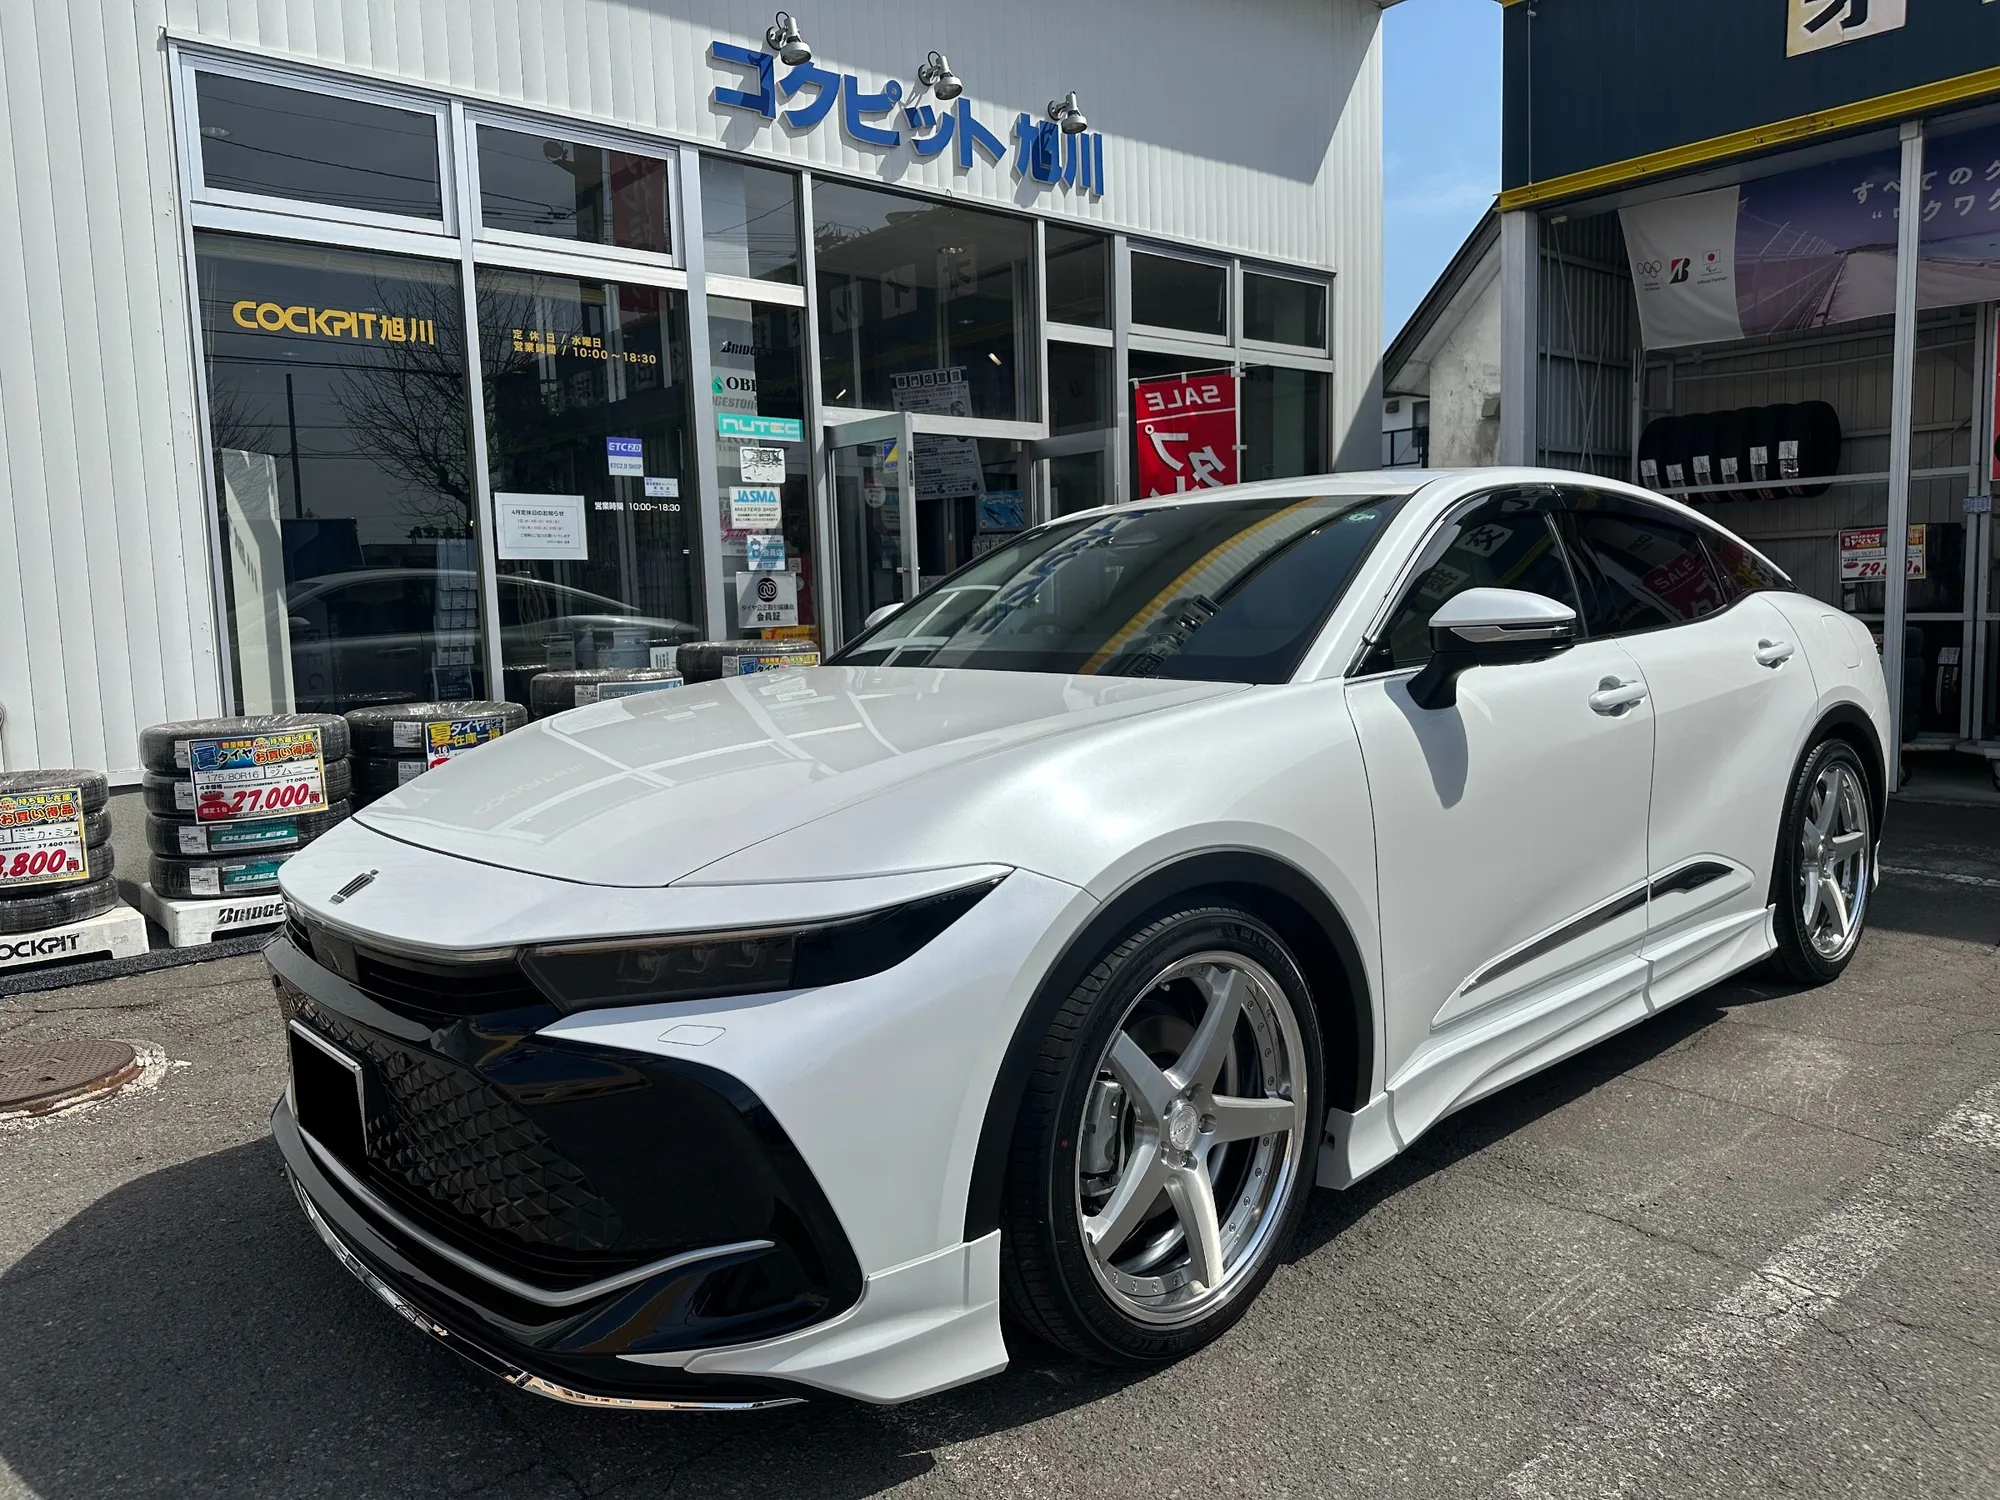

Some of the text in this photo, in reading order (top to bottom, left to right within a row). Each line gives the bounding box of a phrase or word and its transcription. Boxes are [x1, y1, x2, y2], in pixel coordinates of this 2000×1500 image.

[608, 442, 628, 452] ETC
[733, 490, 777, 503] JASMA
[594, 501, 624, 511] 営業時間
[756, 612, 781, 622] 会員証
[254, 741, 316, 764] お買い得品
[437, 745, 448, 754] 16
[207, 770, 260, 782] 175/80R16
[0, 802, 75, 826] お買い得品
[221, 830, 289, 842] DUELER
